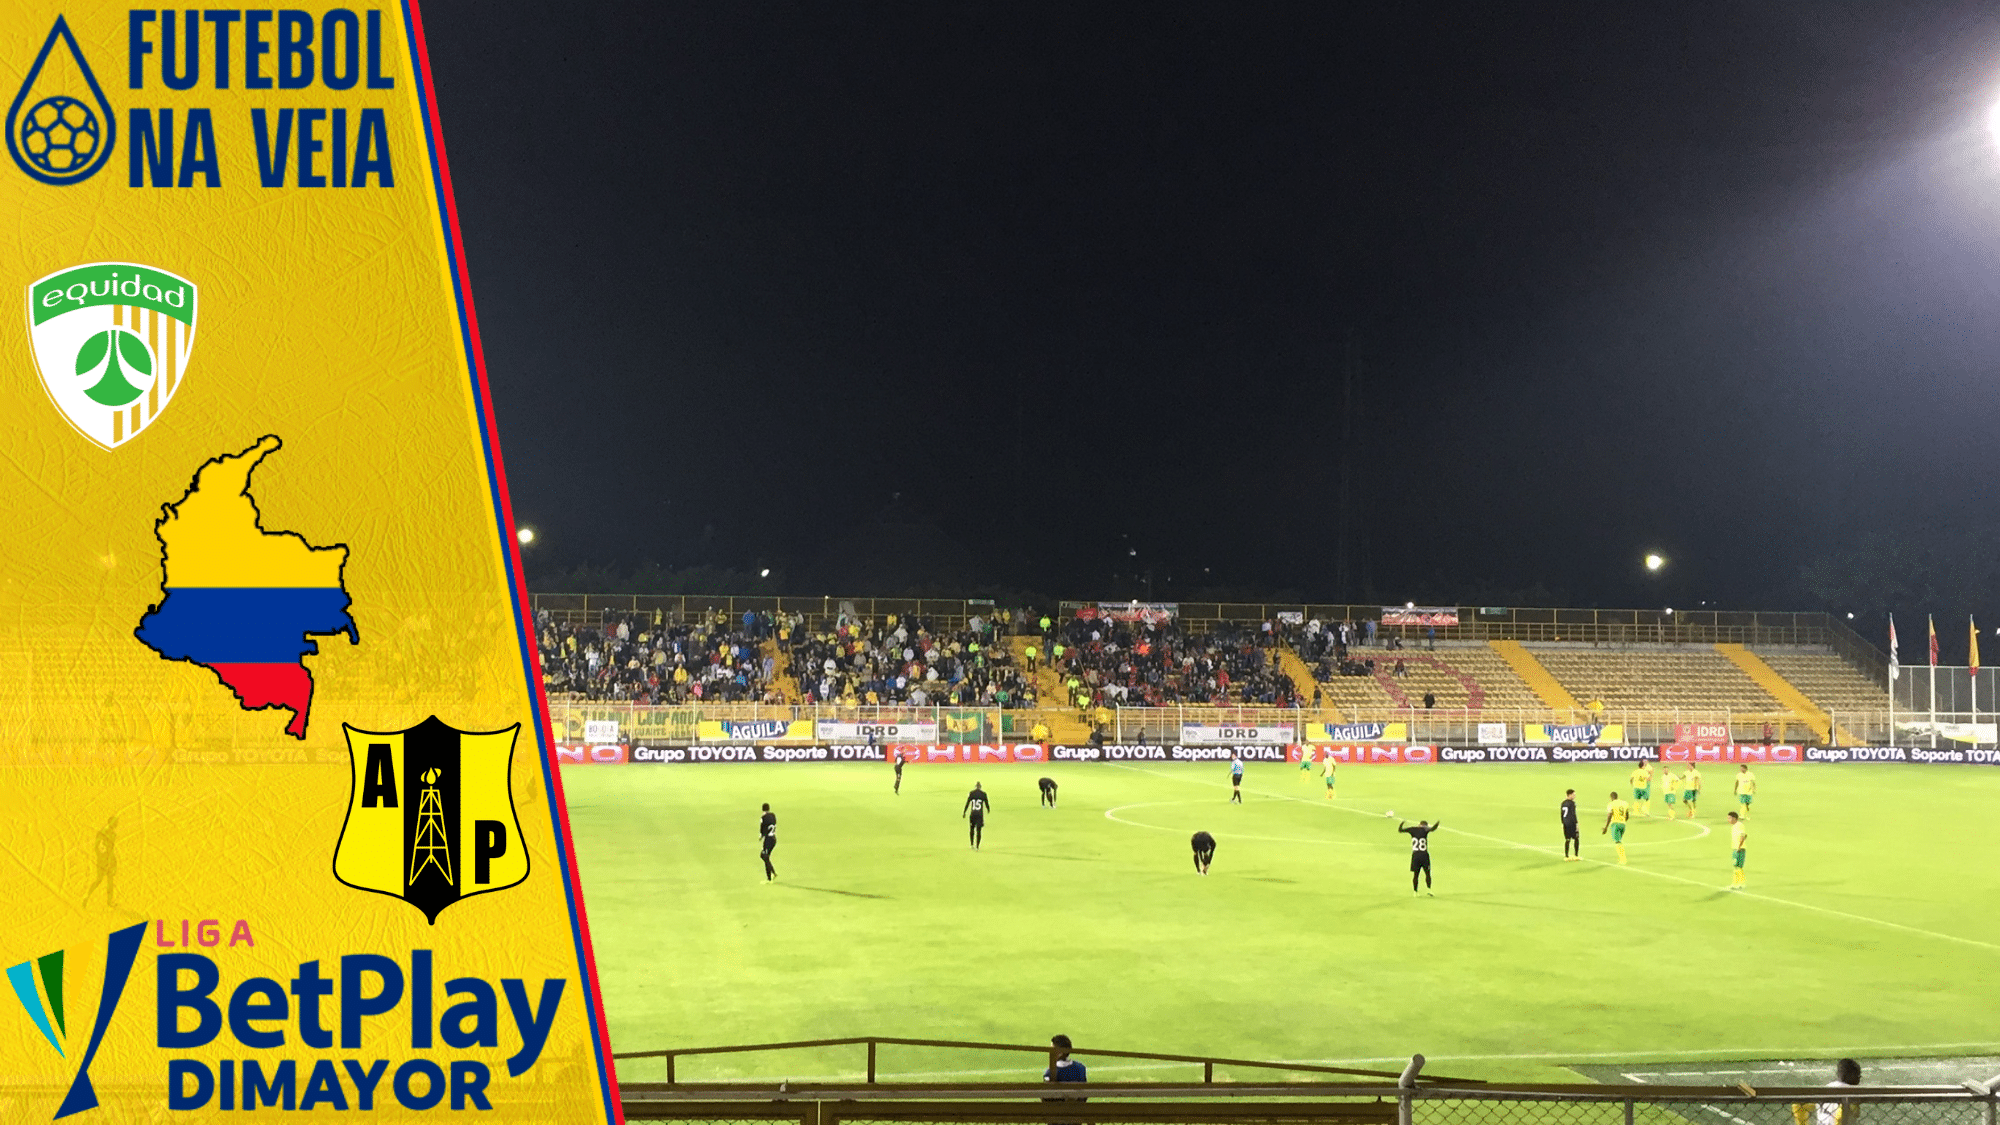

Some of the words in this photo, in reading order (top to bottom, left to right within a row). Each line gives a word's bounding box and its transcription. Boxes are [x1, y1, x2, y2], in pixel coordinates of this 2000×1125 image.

[732, 721, 784, 739] AGUILA
[856, 726, 898, 736] IDRD
[1218, 728, 1258, 738] IDRD
[1334, 723, 1380, 740] AGUILA
[1697, 726, 1726, 737] IDRD
[634, 747, 685, 763] Grupo
[688, 746, 756, 760] TOYOTA
[763, 746, 827, 762] Soporte
[830, 745, 885, 759] TOTAL
[928, 745, 1042, 761] HINO
[1054, 746, 1100, 761] Grupo
[1102, 746, 1166, 759] TOYOTA
[1172, 746, 1231, 761] Soporte
[1234, 746, 1284, 759] TOTAL
[1441, 747, 1485, 762] Grupo
[1487, 747, 1547, 760] TOYOTA
[1553, 747, 1608, 762] Soporte
[1610, 747, 1658, 759] TOTAL
[1696, 746, 1796, 761] HINO
[1806, 748, 1848, 762] Grupo
[1850, 748, 1906, 760] TOYOTA
[1911, 748, 1963, 763] Soporte
[971, 799, 982, 810] 15
[1562, 806, 1569, 818] 7
[1412, 837, 1427, 851] 28
